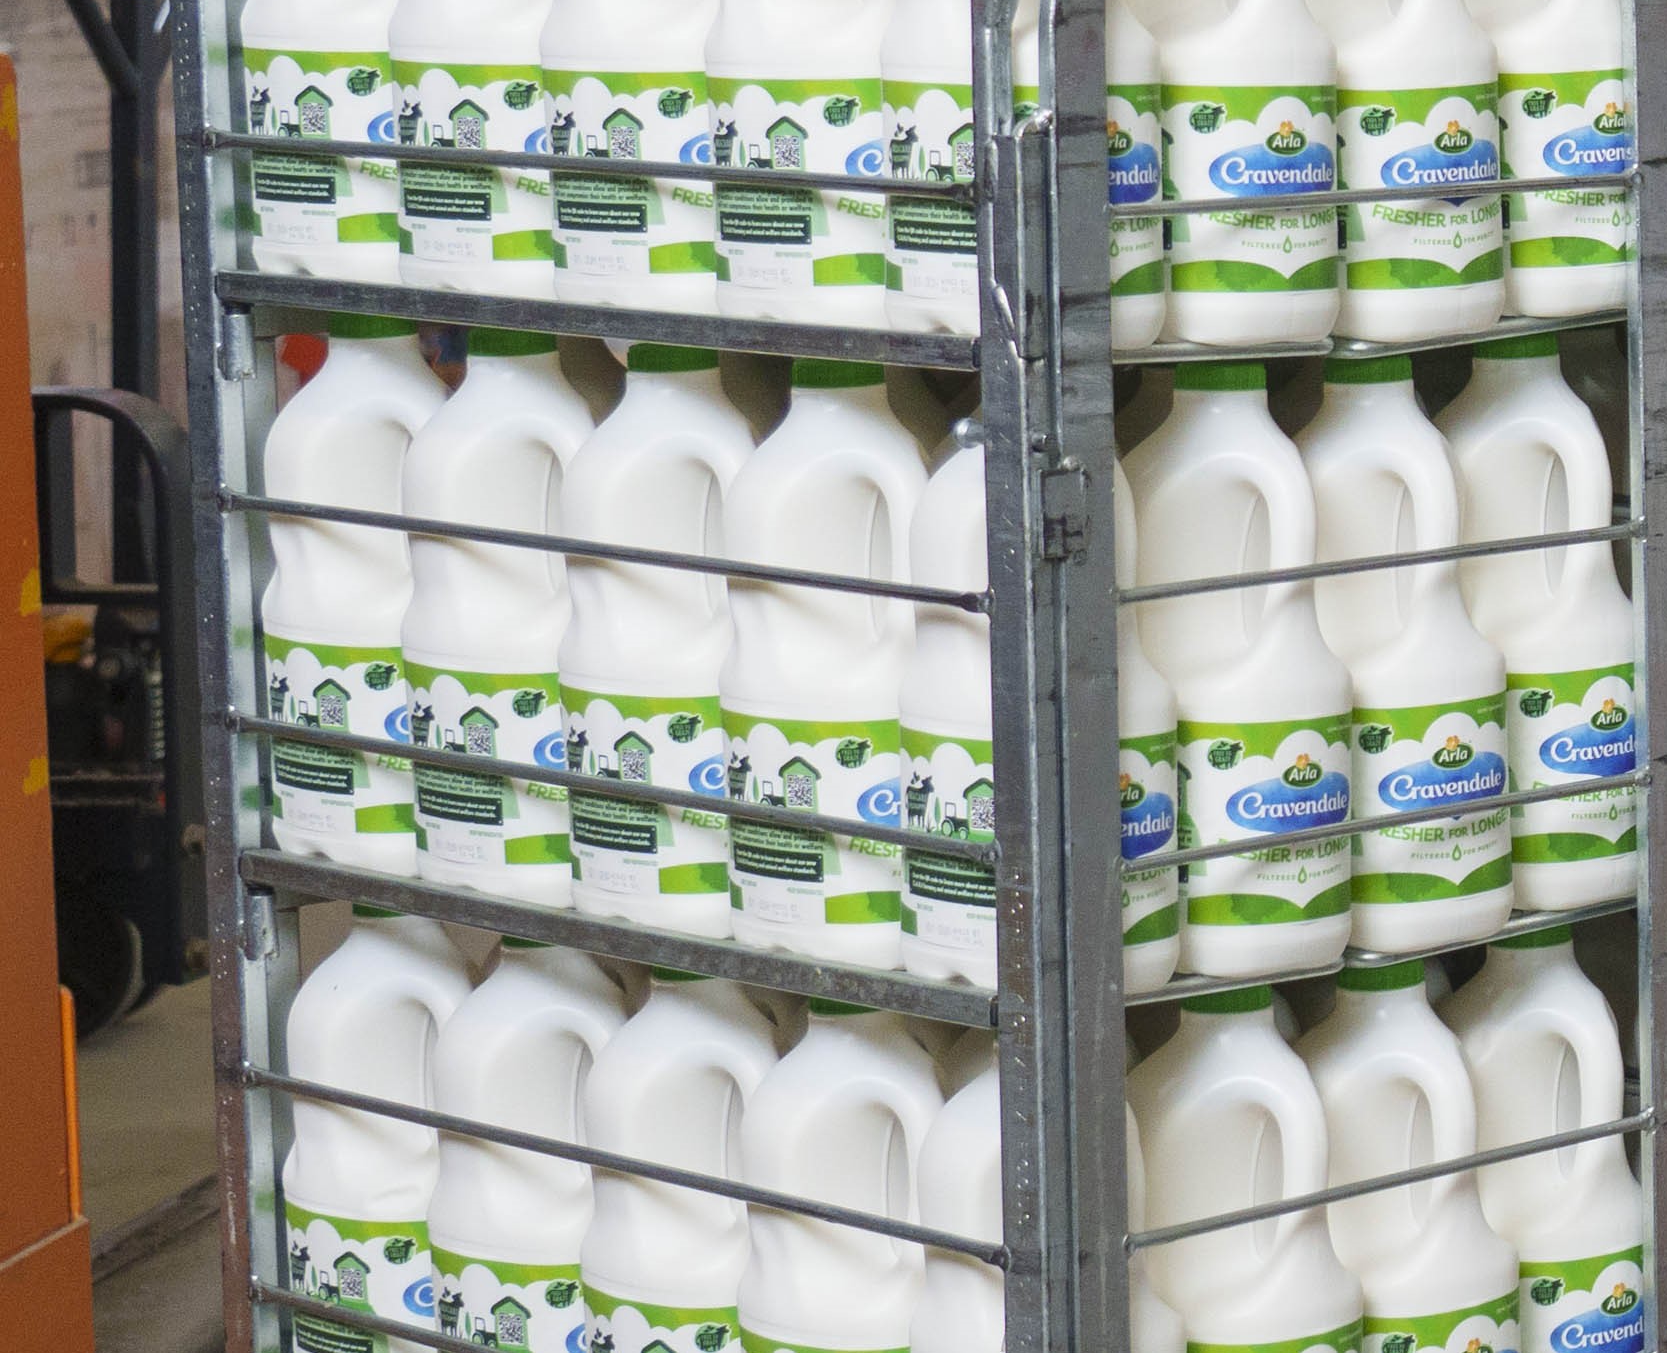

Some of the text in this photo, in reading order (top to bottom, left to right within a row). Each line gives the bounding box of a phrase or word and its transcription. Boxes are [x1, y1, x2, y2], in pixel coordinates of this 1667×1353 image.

[1599, 114, 1624, 129] Arla
[1272, 136, 1301, 148] Arla
[1440, 134, 1467, 148] Arla
[1221, 156, 1333, 184] Cravendale
[1392, 157, 1497, 184] Cravendale
[837, 197, 886, 219] FRES
[1372, 203, 1468, 227] FRESHER FOR
[1280, 219, 1300, 229] FOR
[1596, 711, 1623, 725] Arla
[1439, 748, 1468, 763] Arla
[1288, 766, 1319, 781] Arla
[1389, 771, 1502, 801] Cravendale
[1238, 790, 1348, 820] Cravendale
[1450, 827, 1469, 838] FOR
[1607, 1291, 1633, 1312] Arla
